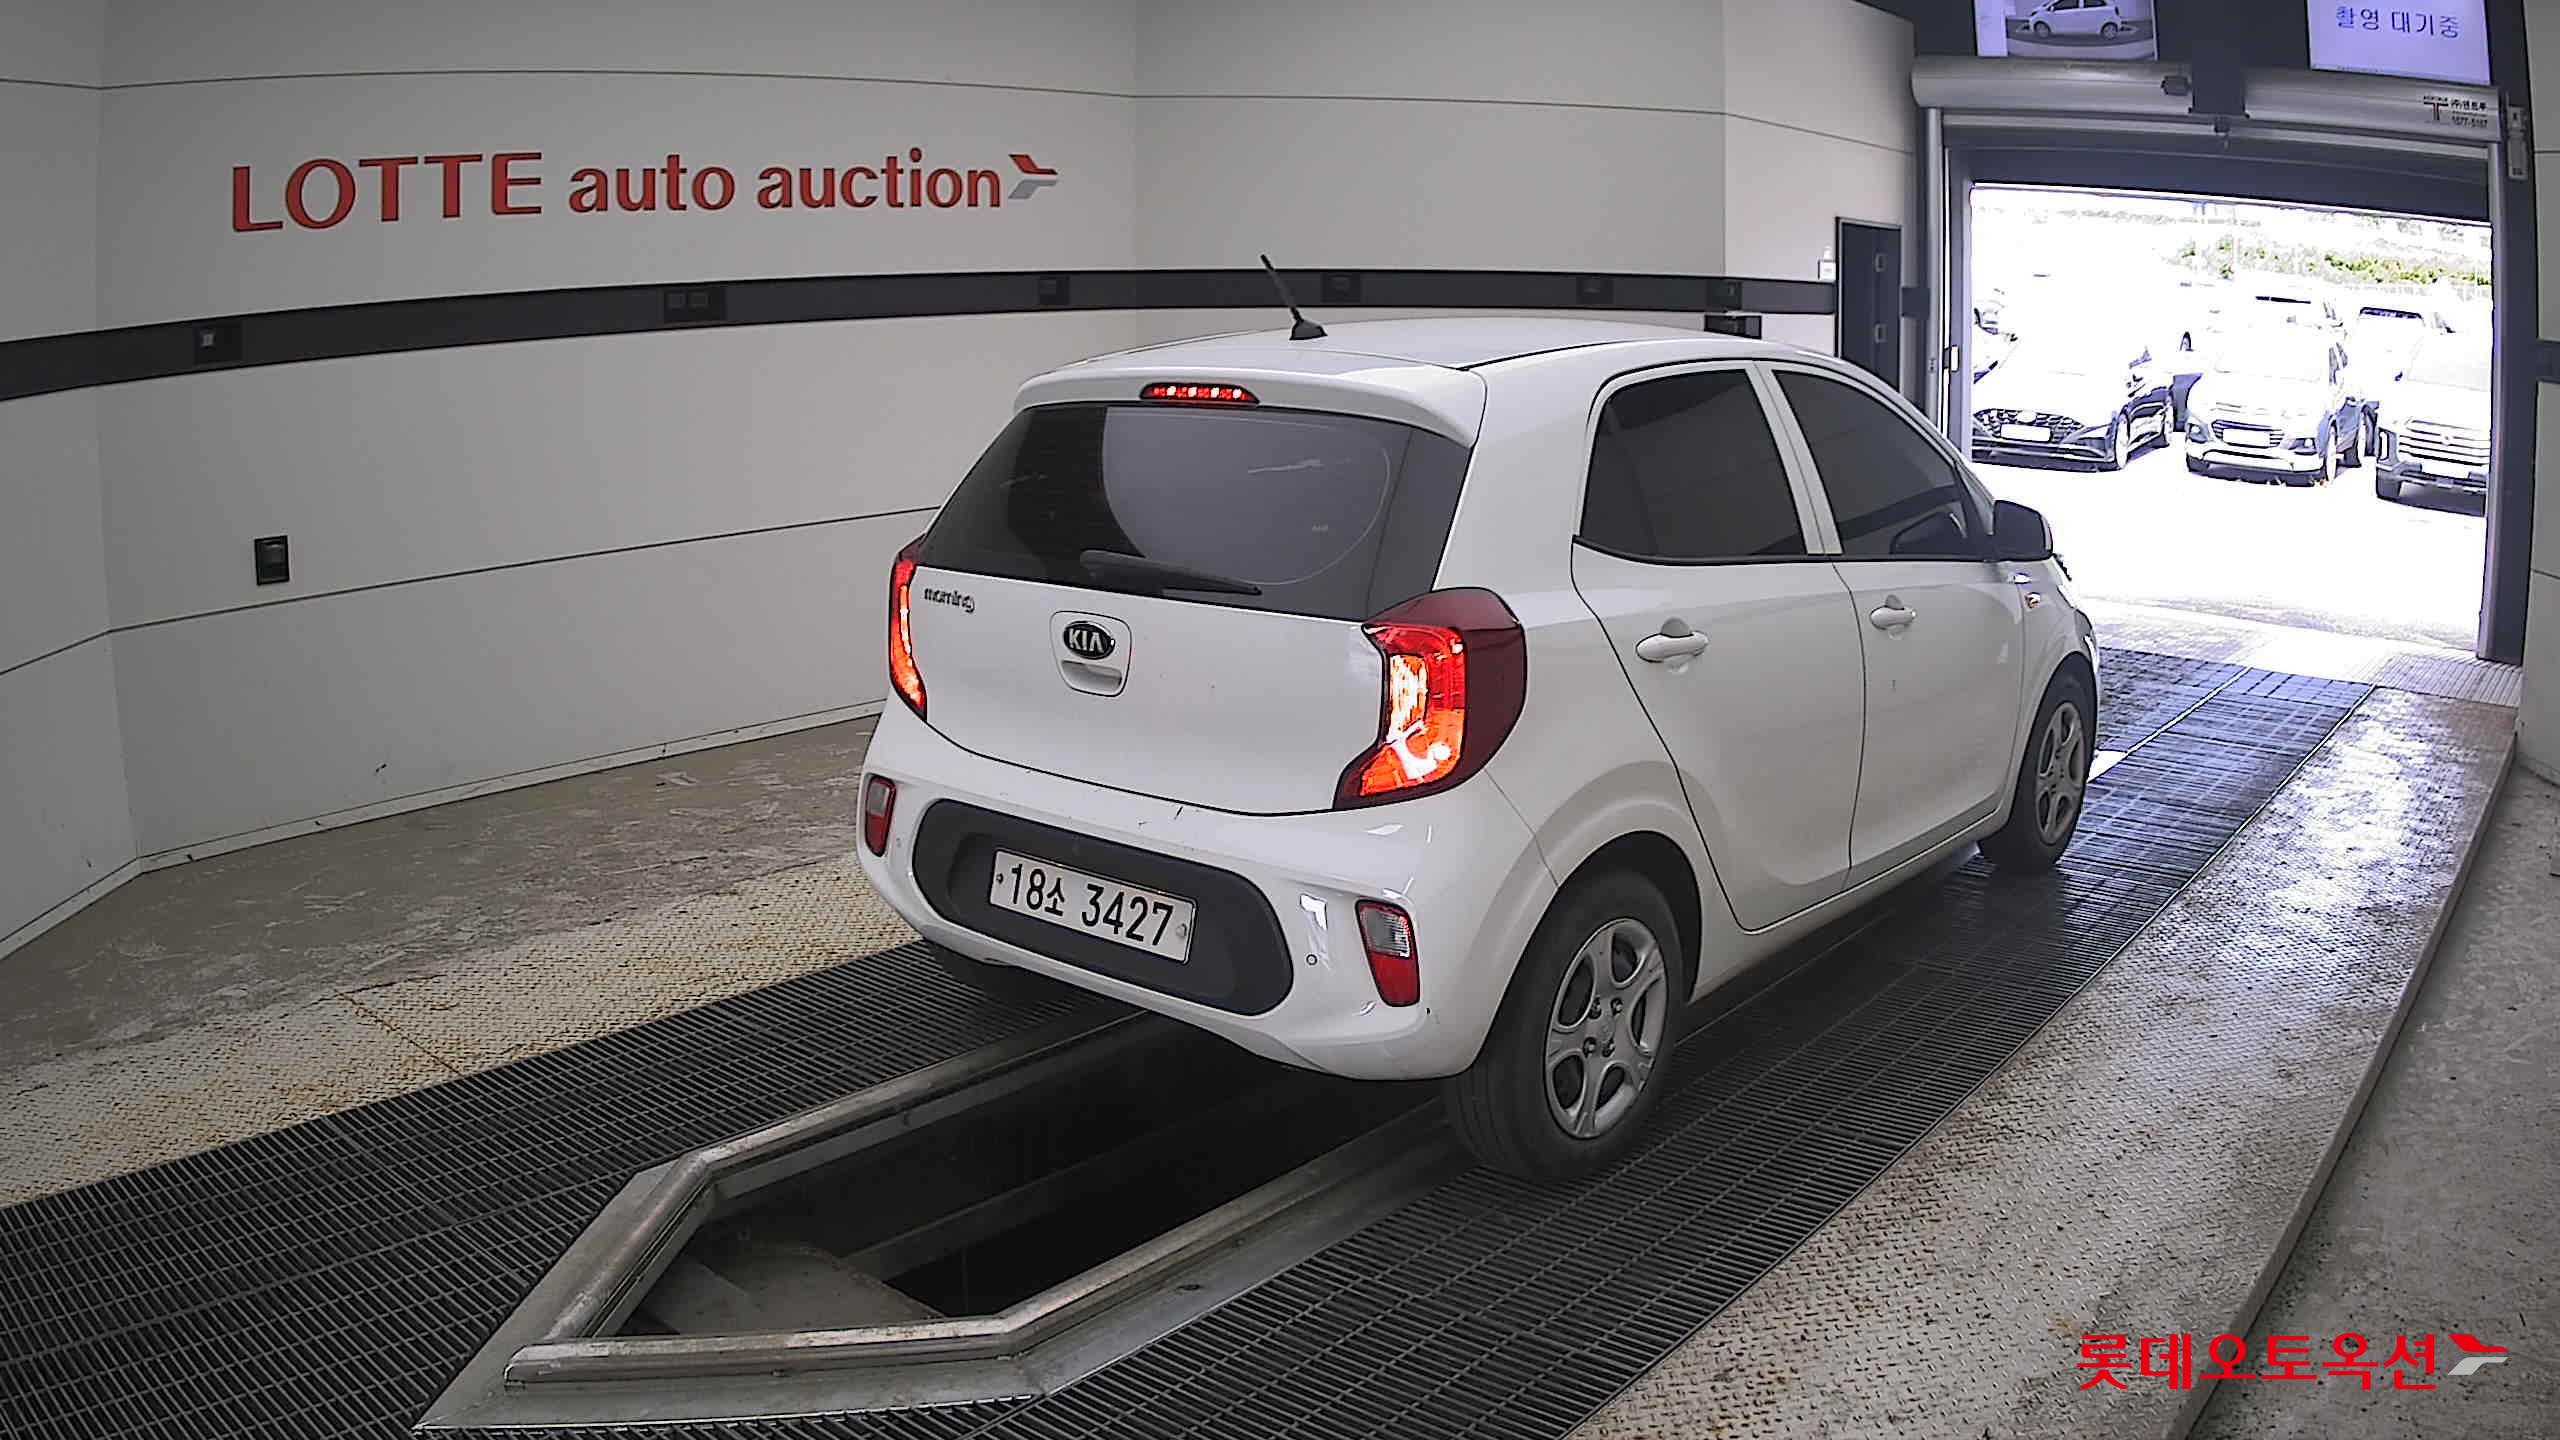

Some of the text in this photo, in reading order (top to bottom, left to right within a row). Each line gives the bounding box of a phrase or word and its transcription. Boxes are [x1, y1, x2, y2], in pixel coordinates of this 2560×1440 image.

[2391, 11, 2459, 39] 대기중
[233, 147, 1001, 232] LOTTE auto auction
[924, 588, 975, 613] morning
[1067, 627, 1104, 653] KIA
[1011, 862, 1174, 947] 18소 3427
